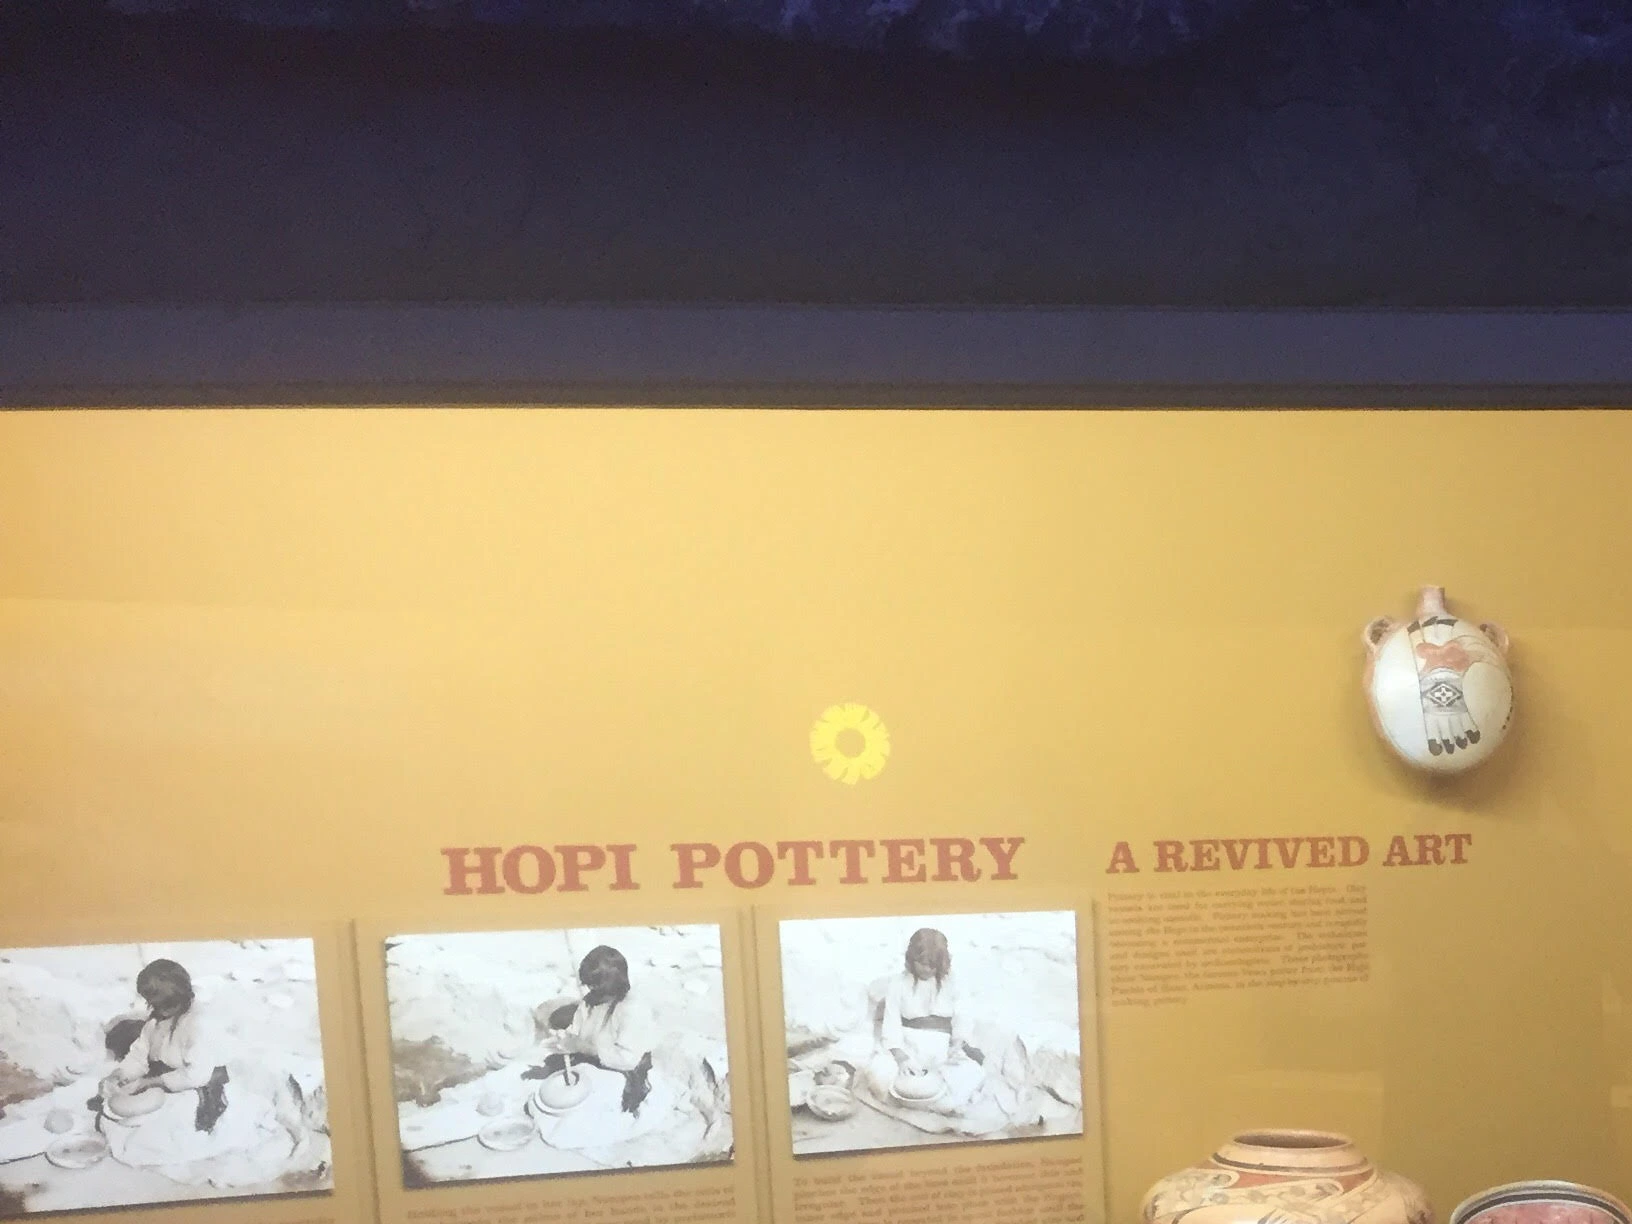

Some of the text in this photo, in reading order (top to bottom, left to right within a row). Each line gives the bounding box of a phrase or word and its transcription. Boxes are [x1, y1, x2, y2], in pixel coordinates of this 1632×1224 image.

[440, 836, 1026, 896] HOPI POTTERY
[1105, 833, 1473, 873] A REVIVED ART
